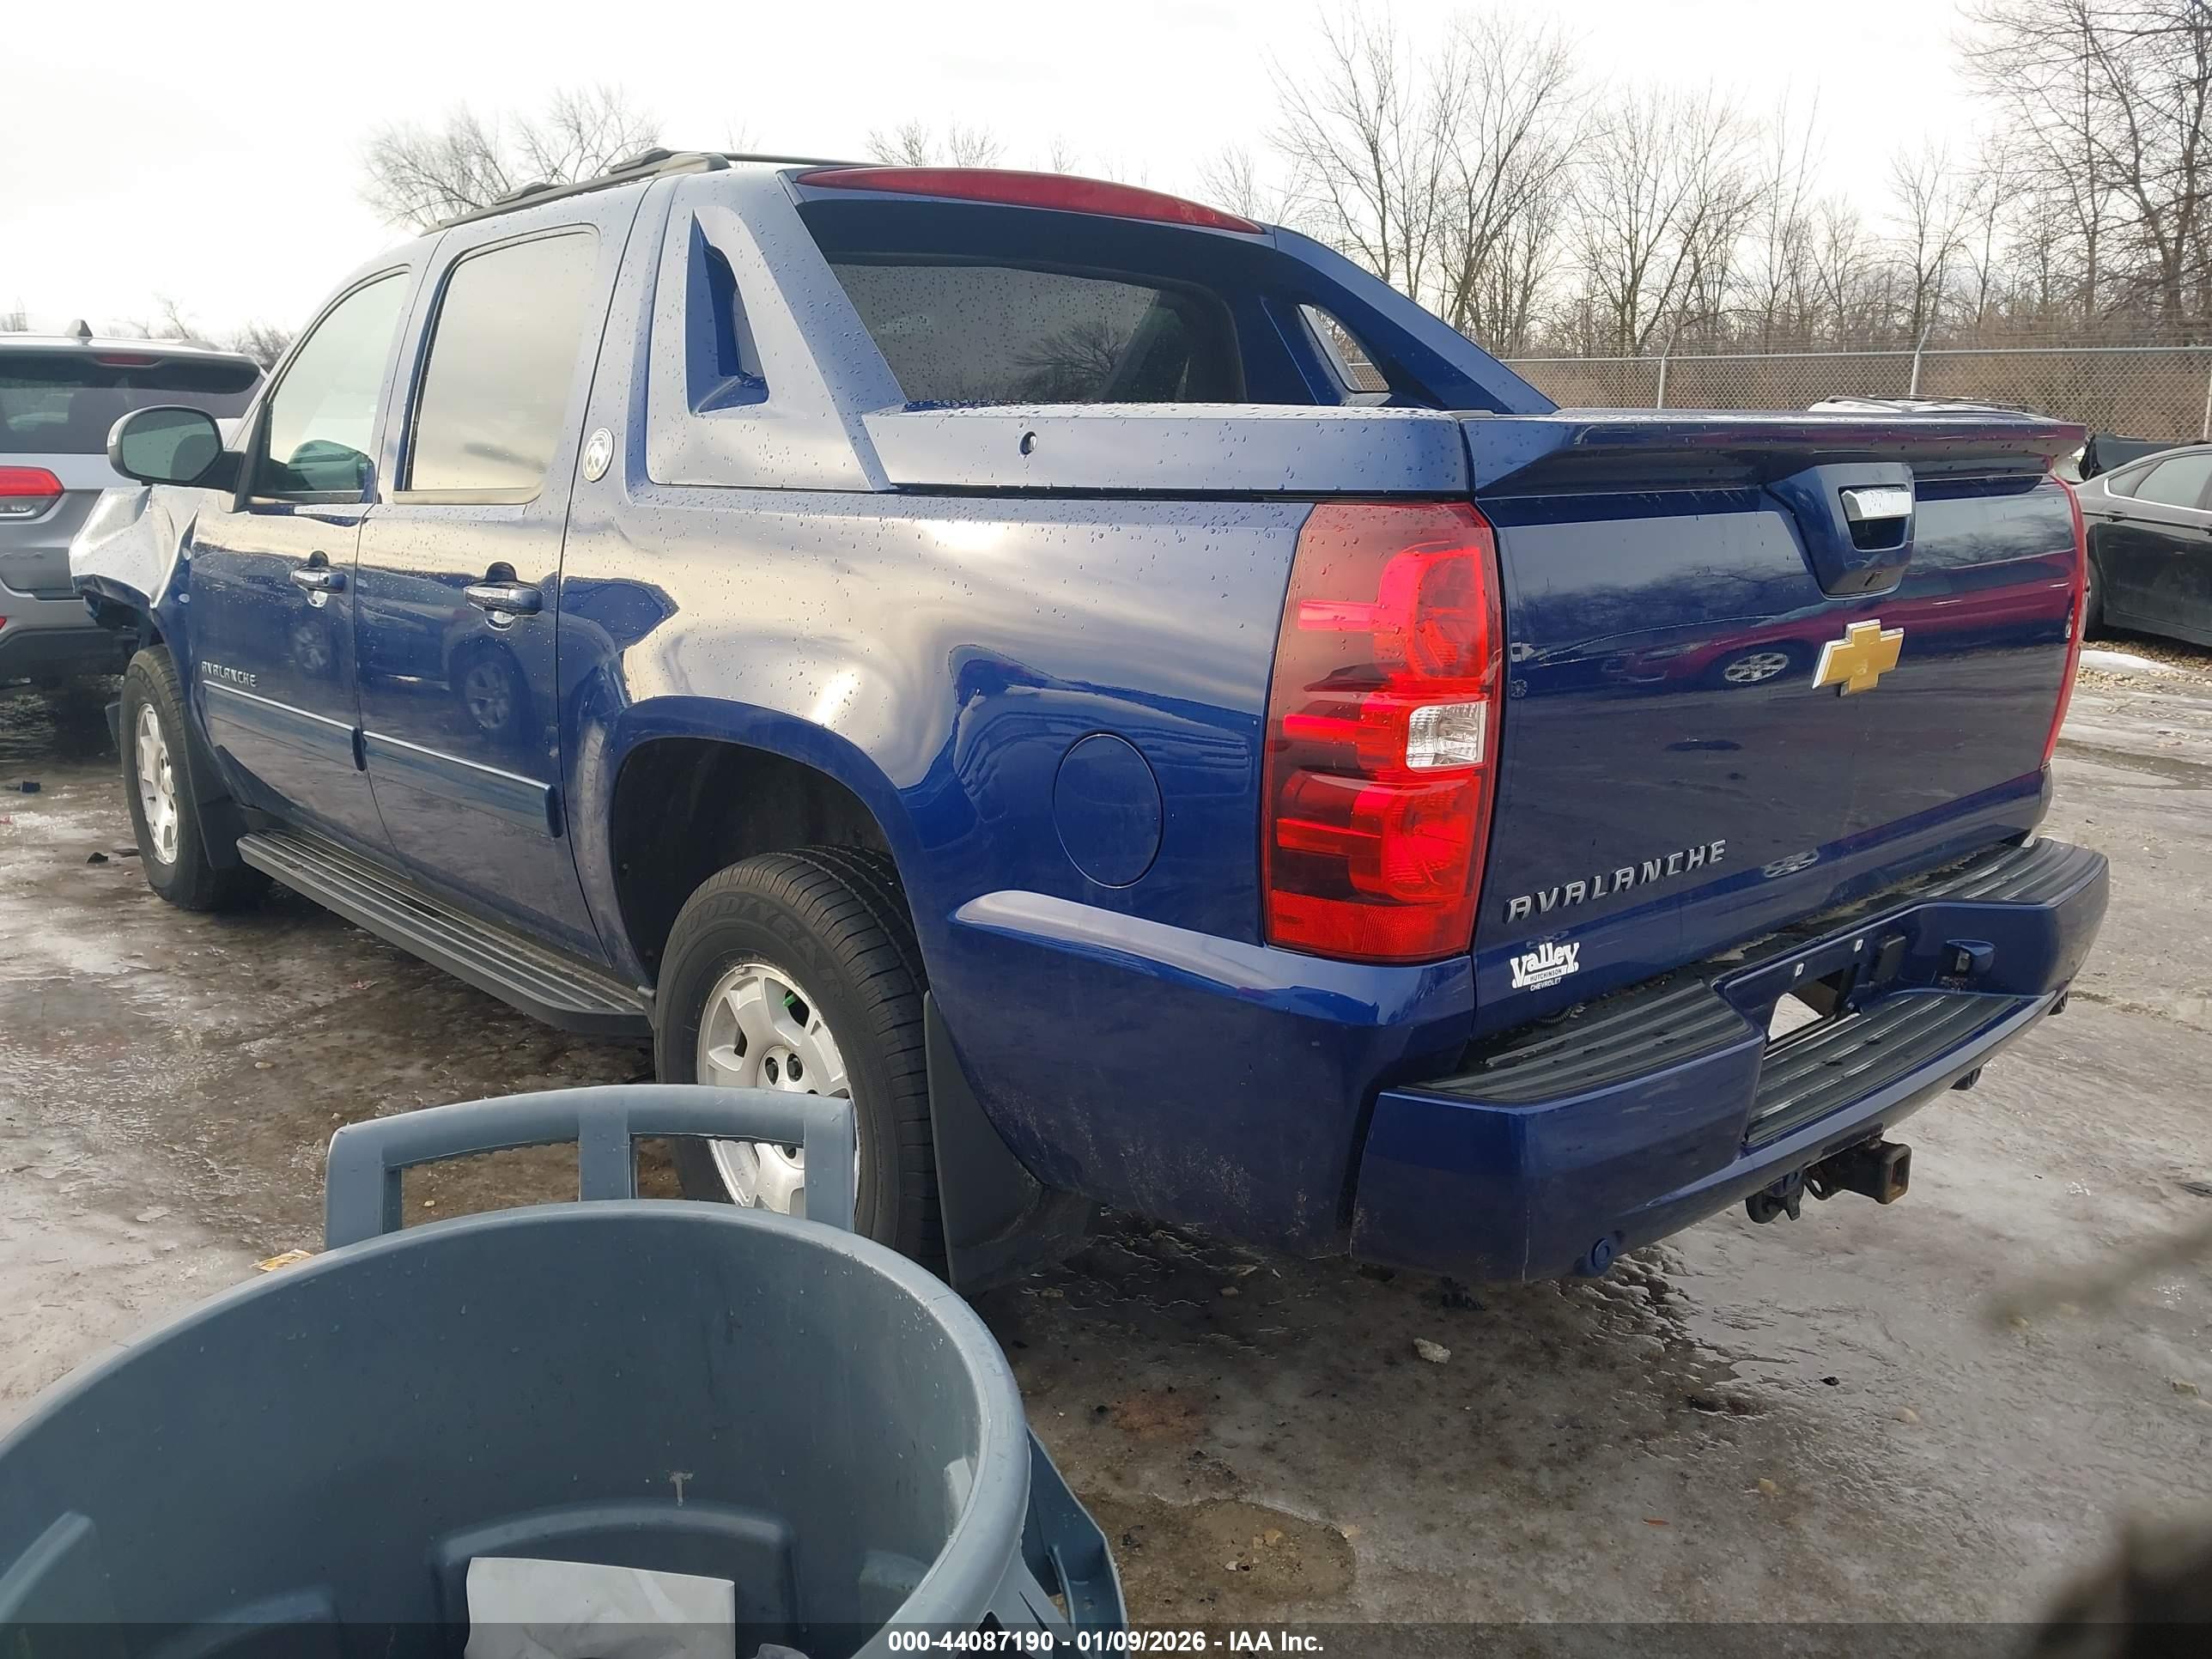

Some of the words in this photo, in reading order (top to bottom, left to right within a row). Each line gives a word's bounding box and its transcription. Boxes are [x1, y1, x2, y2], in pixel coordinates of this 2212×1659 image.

[201, 660, 258, 687] AVALANCHE
[1503, 839, 1728, 924] AVALANCHE
[1510, 942, 1580, 989] Valley
[1529, 968, 1563, 982] HUTCHINSON
[1529, 977, 1563, 992] CHEVROLET
